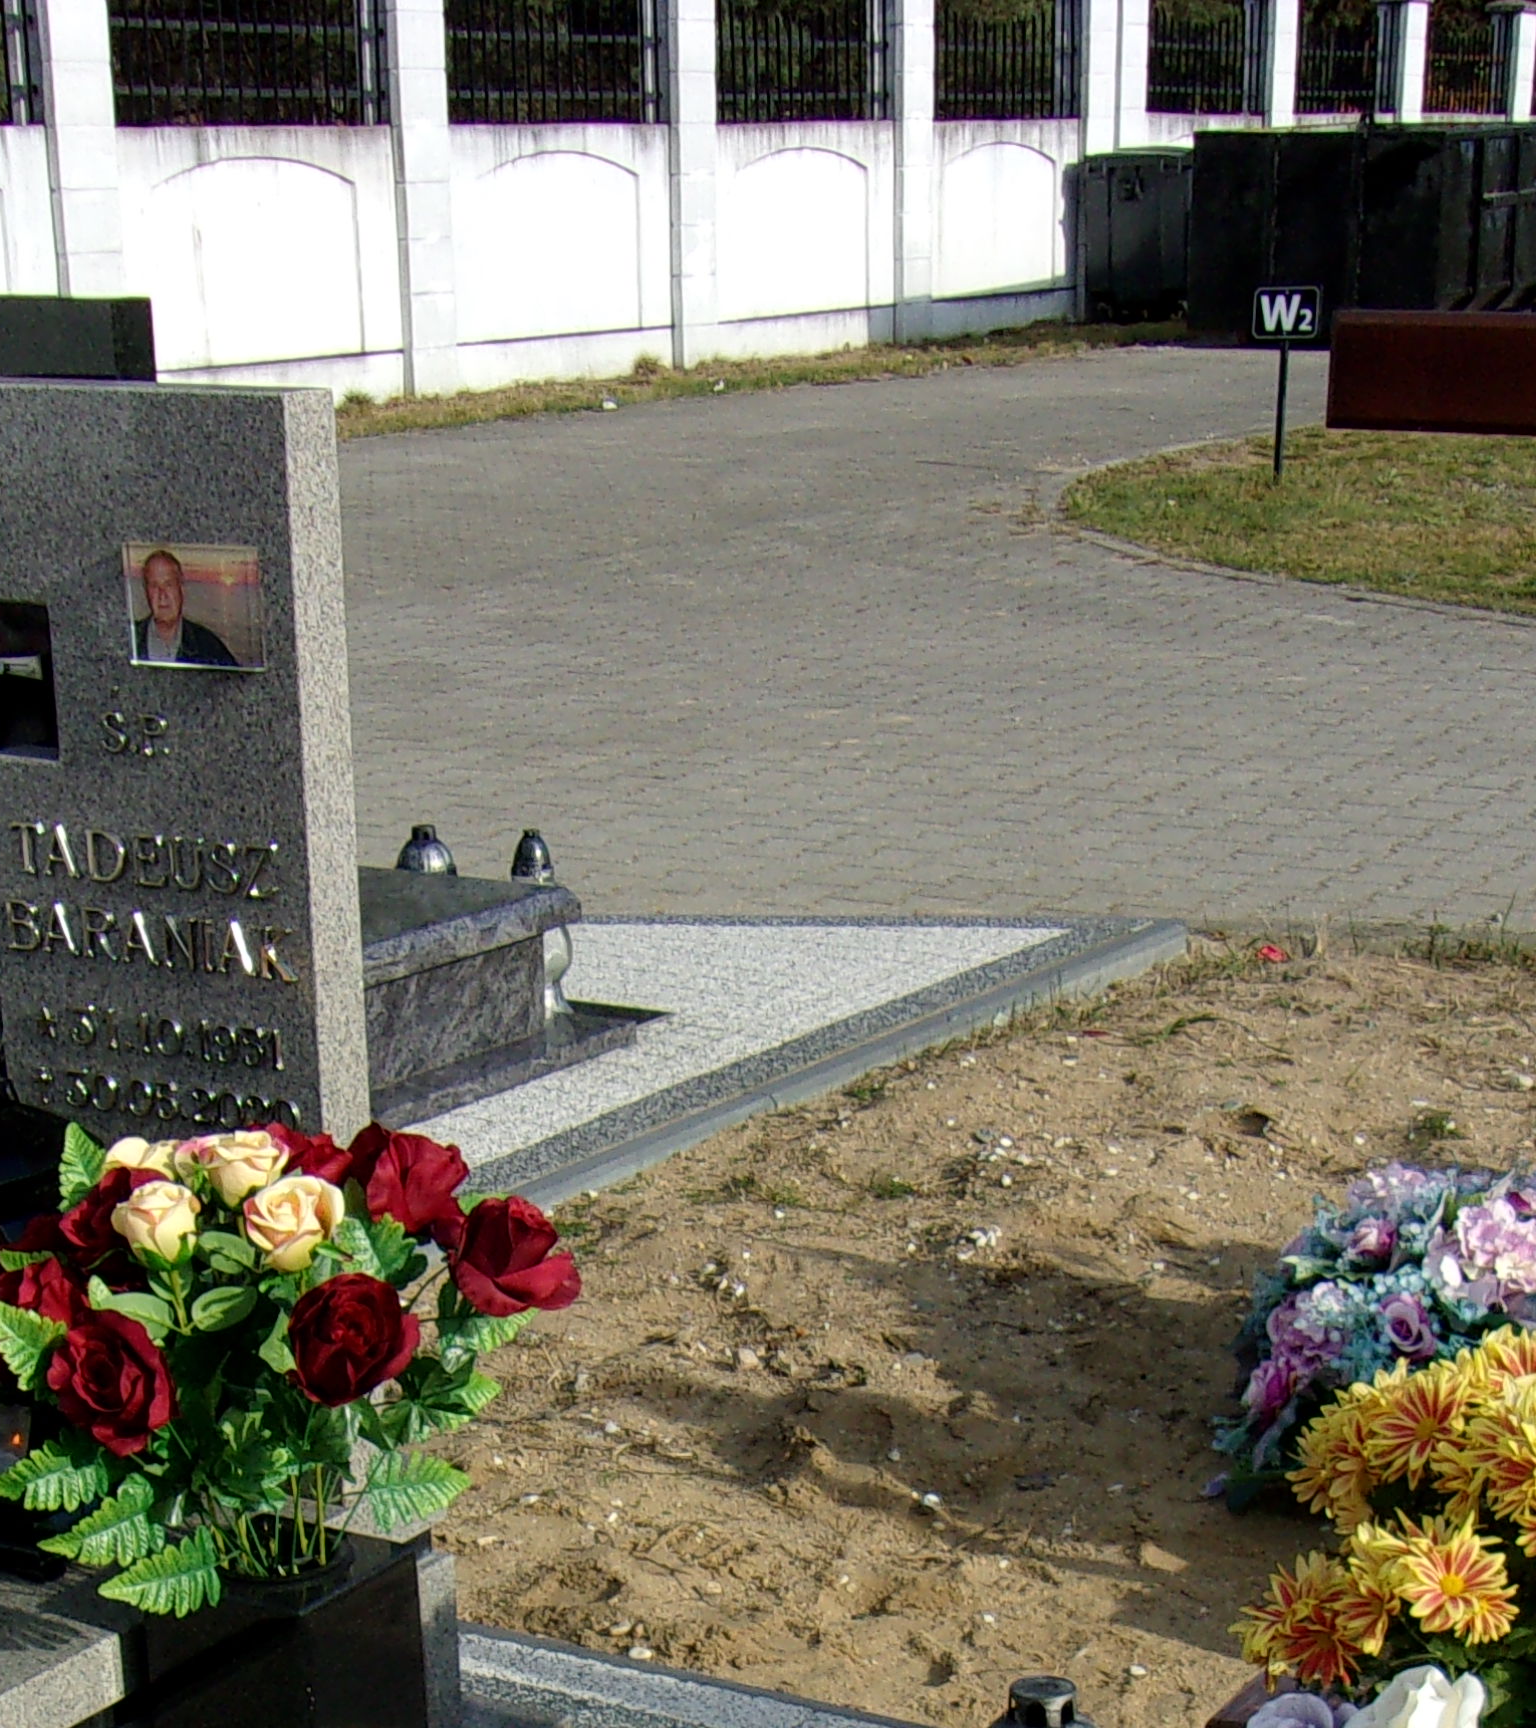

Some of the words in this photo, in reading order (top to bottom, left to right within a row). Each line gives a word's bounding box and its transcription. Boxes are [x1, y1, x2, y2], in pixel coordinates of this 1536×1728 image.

[1260, 293, 1313, 332] W2
[9, 820, 282, 900] TADEUSZ
[5, 900, 301, 984] BARANIAK
